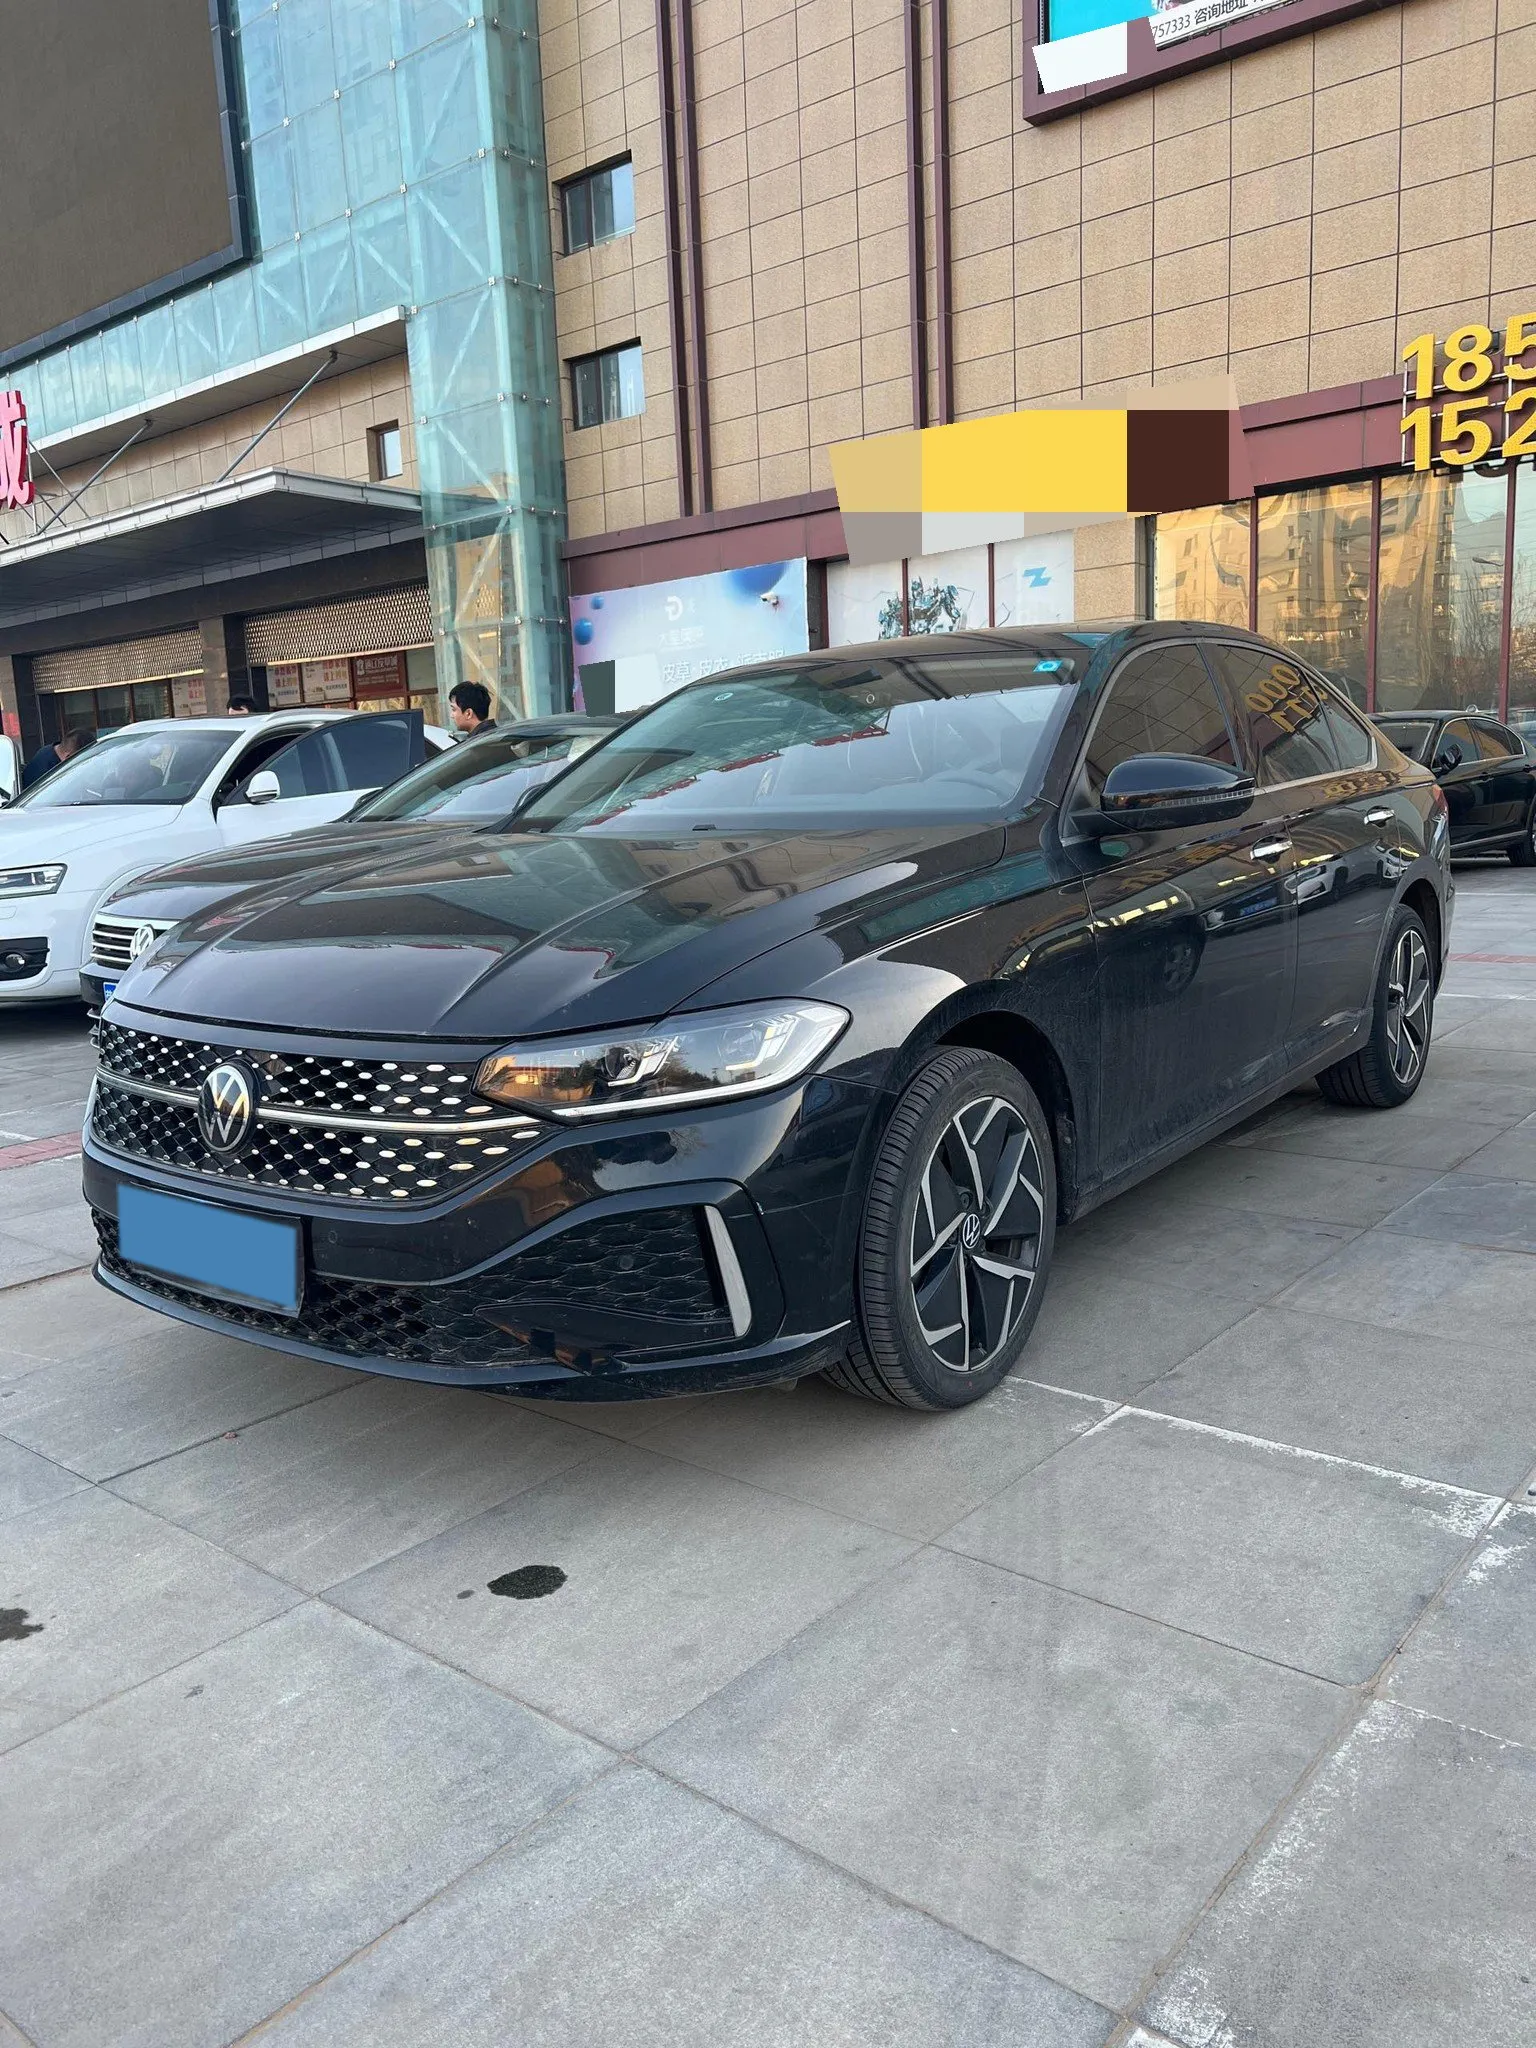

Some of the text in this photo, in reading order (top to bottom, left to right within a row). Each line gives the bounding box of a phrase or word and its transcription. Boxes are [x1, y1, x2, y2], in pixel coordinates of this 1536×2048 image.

[1194, 0, 1248, 24] 咨询地址
[1402, 312, 1536, 400] 185
[1400, 387, 1536, 471] 152
